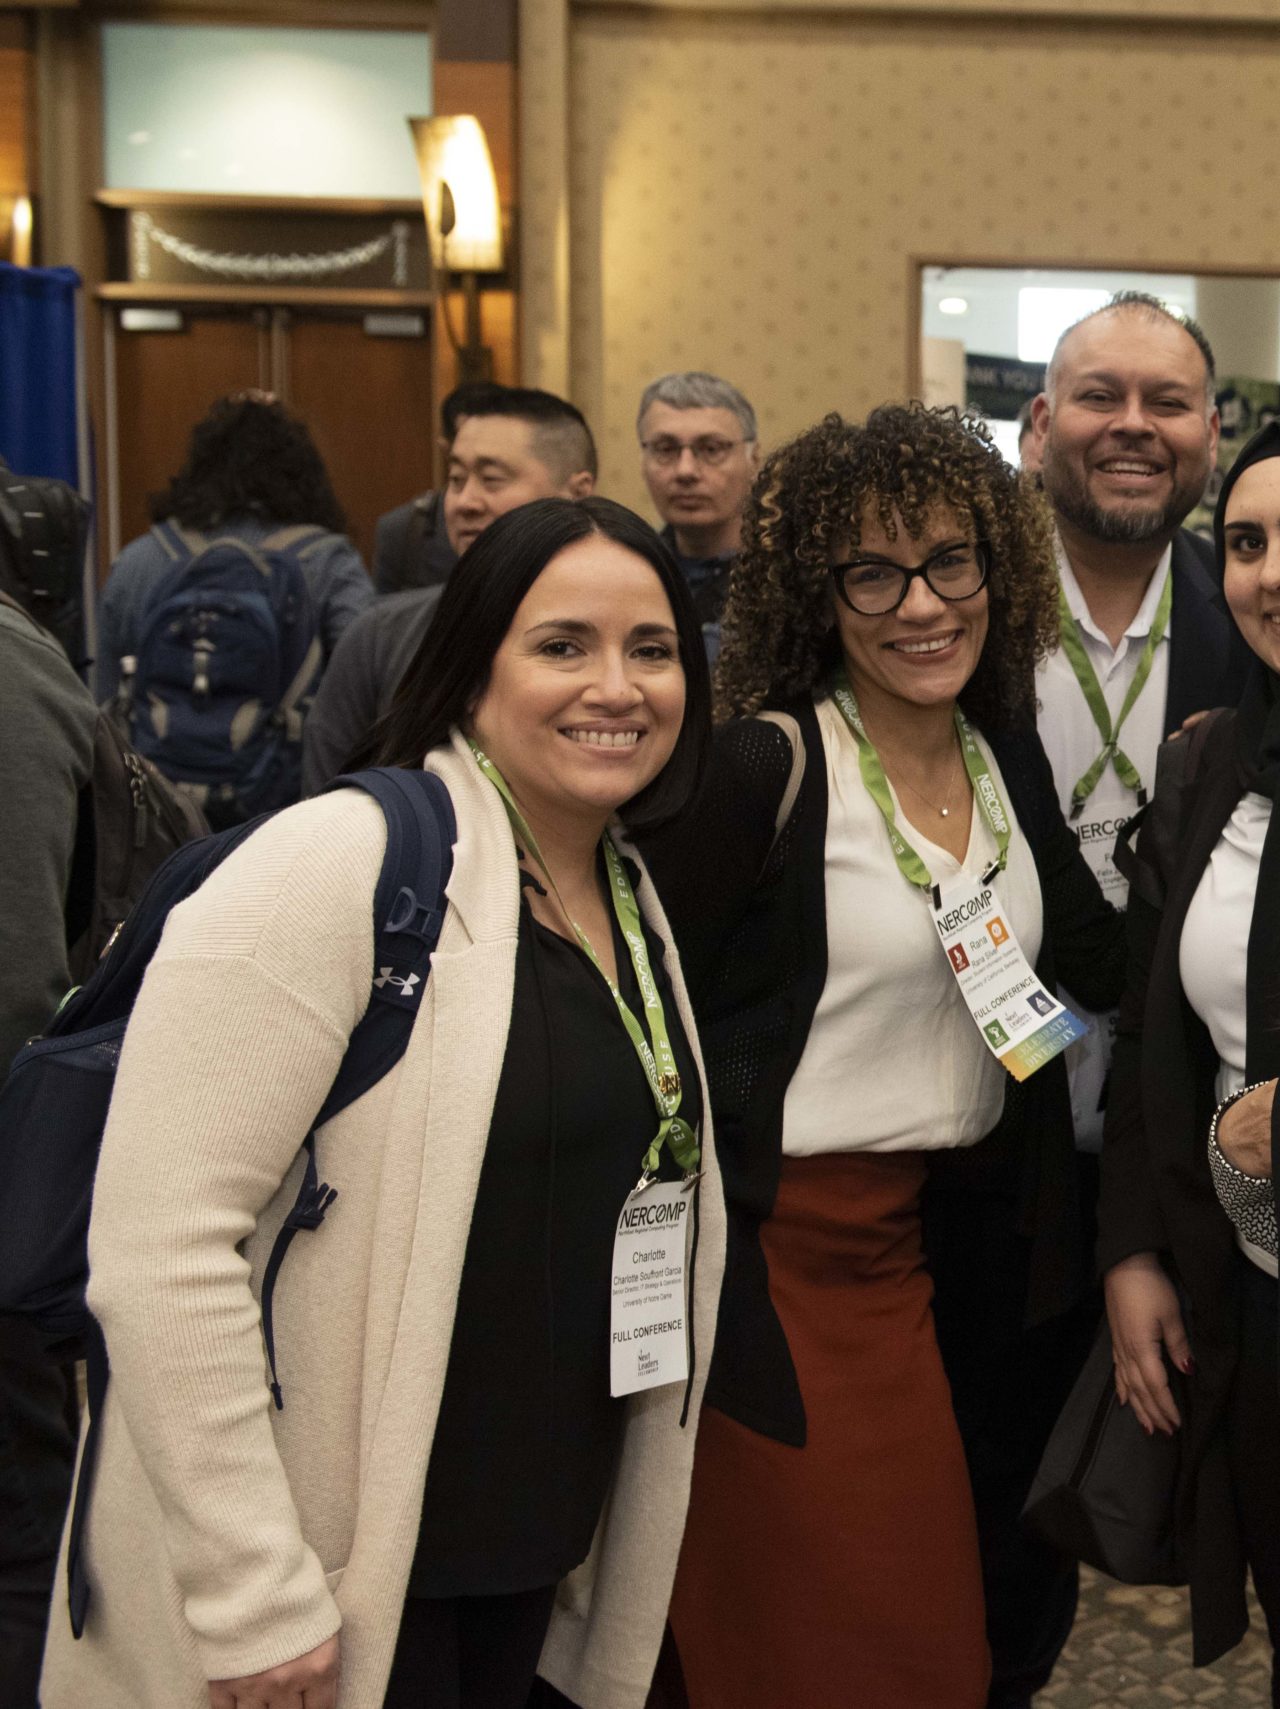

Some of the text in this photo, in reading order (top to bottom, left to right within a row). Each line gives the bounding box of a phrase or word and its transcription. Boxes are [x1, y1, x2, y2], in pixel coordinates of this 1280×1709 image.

[978, 773, 1008, 834] NERCOMP
[937, 889, 992, 935] NERCOMP
[626, 931, 658, 1009] NERCOMP
[974, 976, 1036, 1021] FULL CONFERENCE
[620, 1201, 686, 1229] NERCOMP
[632, 1249, 666, 1264] Charlotte
[613, 1274, 639, 1286] Charlotte
[613, 1319, 683, 1343] FULL CONFERENCE
